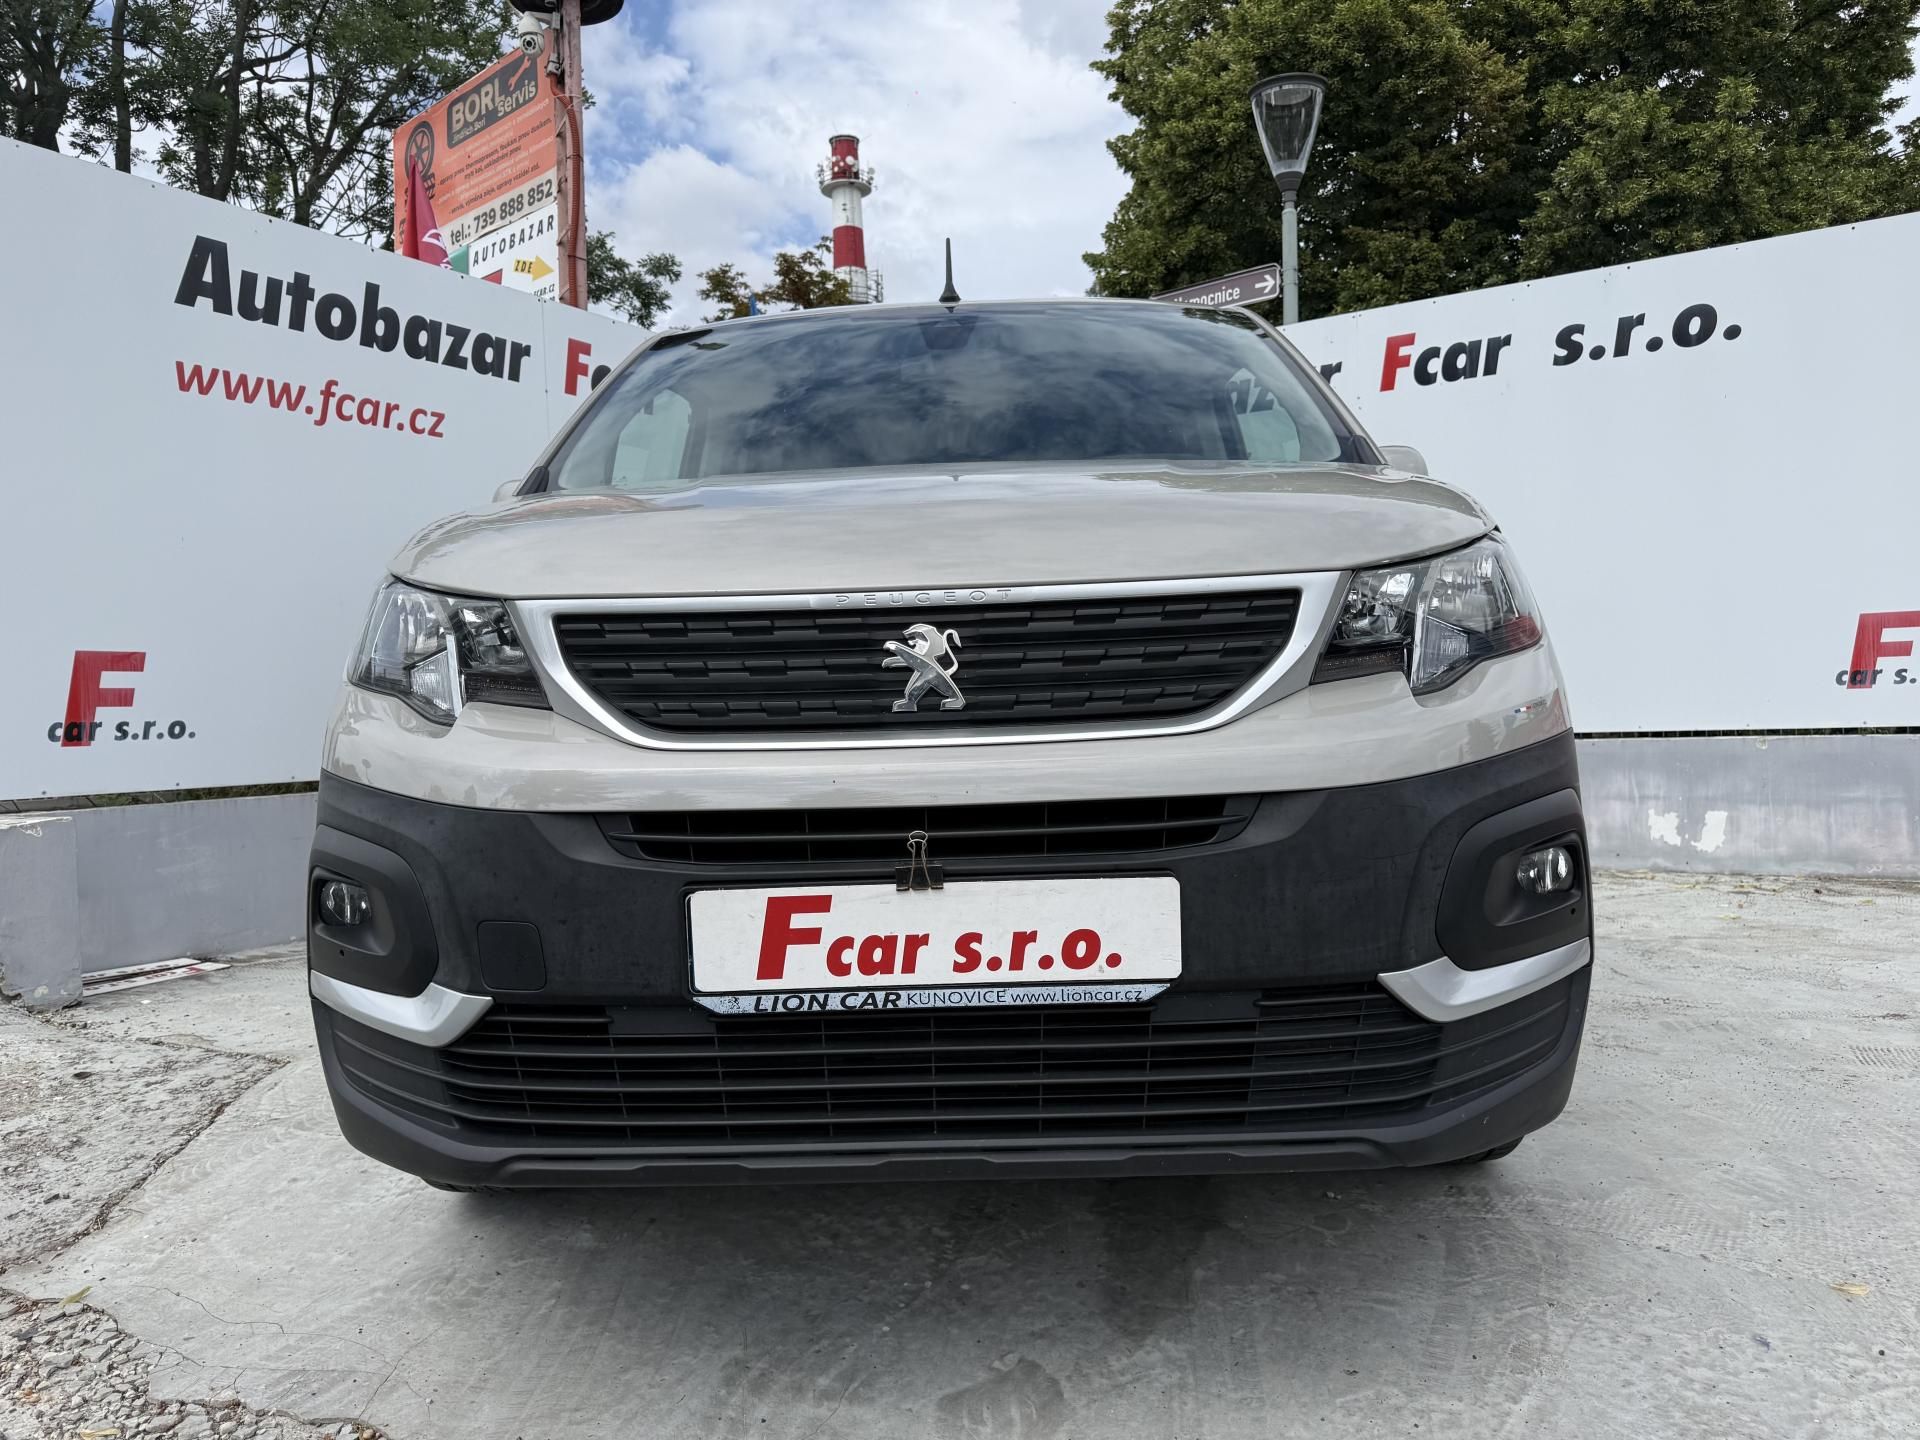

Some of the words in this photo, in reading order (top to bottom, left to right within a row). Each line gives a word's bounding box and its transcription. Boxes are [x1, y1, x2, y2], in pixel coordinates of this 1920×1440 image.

[497, 80, 536, 117] servis
[450, 223, 470, 246] tel.:
[473, 208, 497, 234] 739
[499, 193, 524, 220] 888
[527, 178, 553, 207] 852
[473, 214, 554, 267] AUTOBAZAR
[514, 260, 533, 273] ZDE
[174, 234, 531, 382] Autobazar
[1379, 332, 1513, 392] Fcar
[1552, 303, 1742, 366] s.r.o.
[175, 360, 446, 438] www.fcar.cz
[835, 589, 1012, 607] PEUGEOT
[1835, 668, 1883, 686] car
[47, 720, 102, 742] car
[114, 720, 196, 742] s.r.o.
[756, 894, 930, 981] Fcar
[953, 928, 1122, 974] s.r.o.
[753, 993, 830, 1013] LION
[839, 991, 902, 1011] CAR
[907, 990, 1006, 1006] KUNOVICE
[1010, 988, 1143, 1004] www.lioncar.cz
